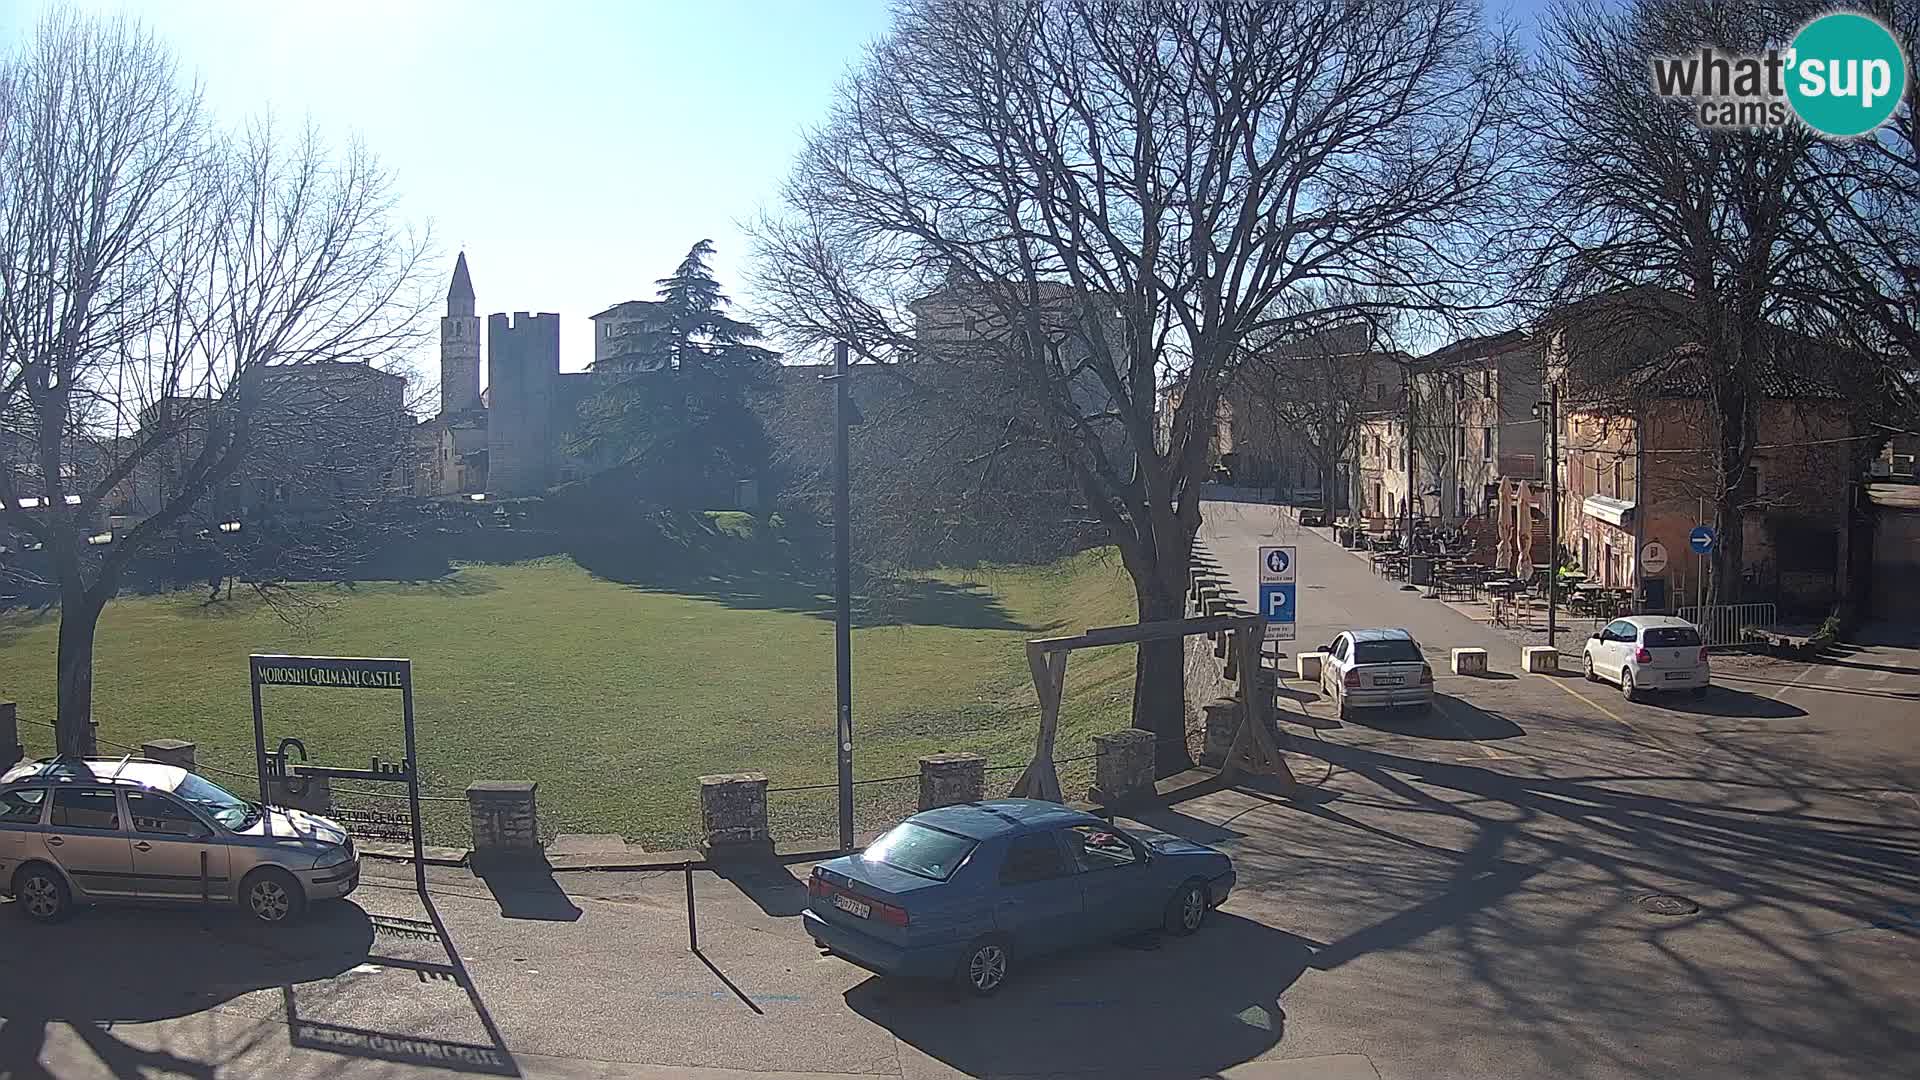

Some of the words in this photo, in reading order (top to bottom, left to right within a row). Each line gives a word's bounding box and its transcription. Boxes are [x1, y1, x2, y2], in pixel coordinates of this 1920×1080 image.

[1269, 592, 1286, 616] P
[258, 666, 308, 684] MOROSINI
[309, 667, 360, 687] GRIMANI
[361, 670, 402, 687] CASTLE
